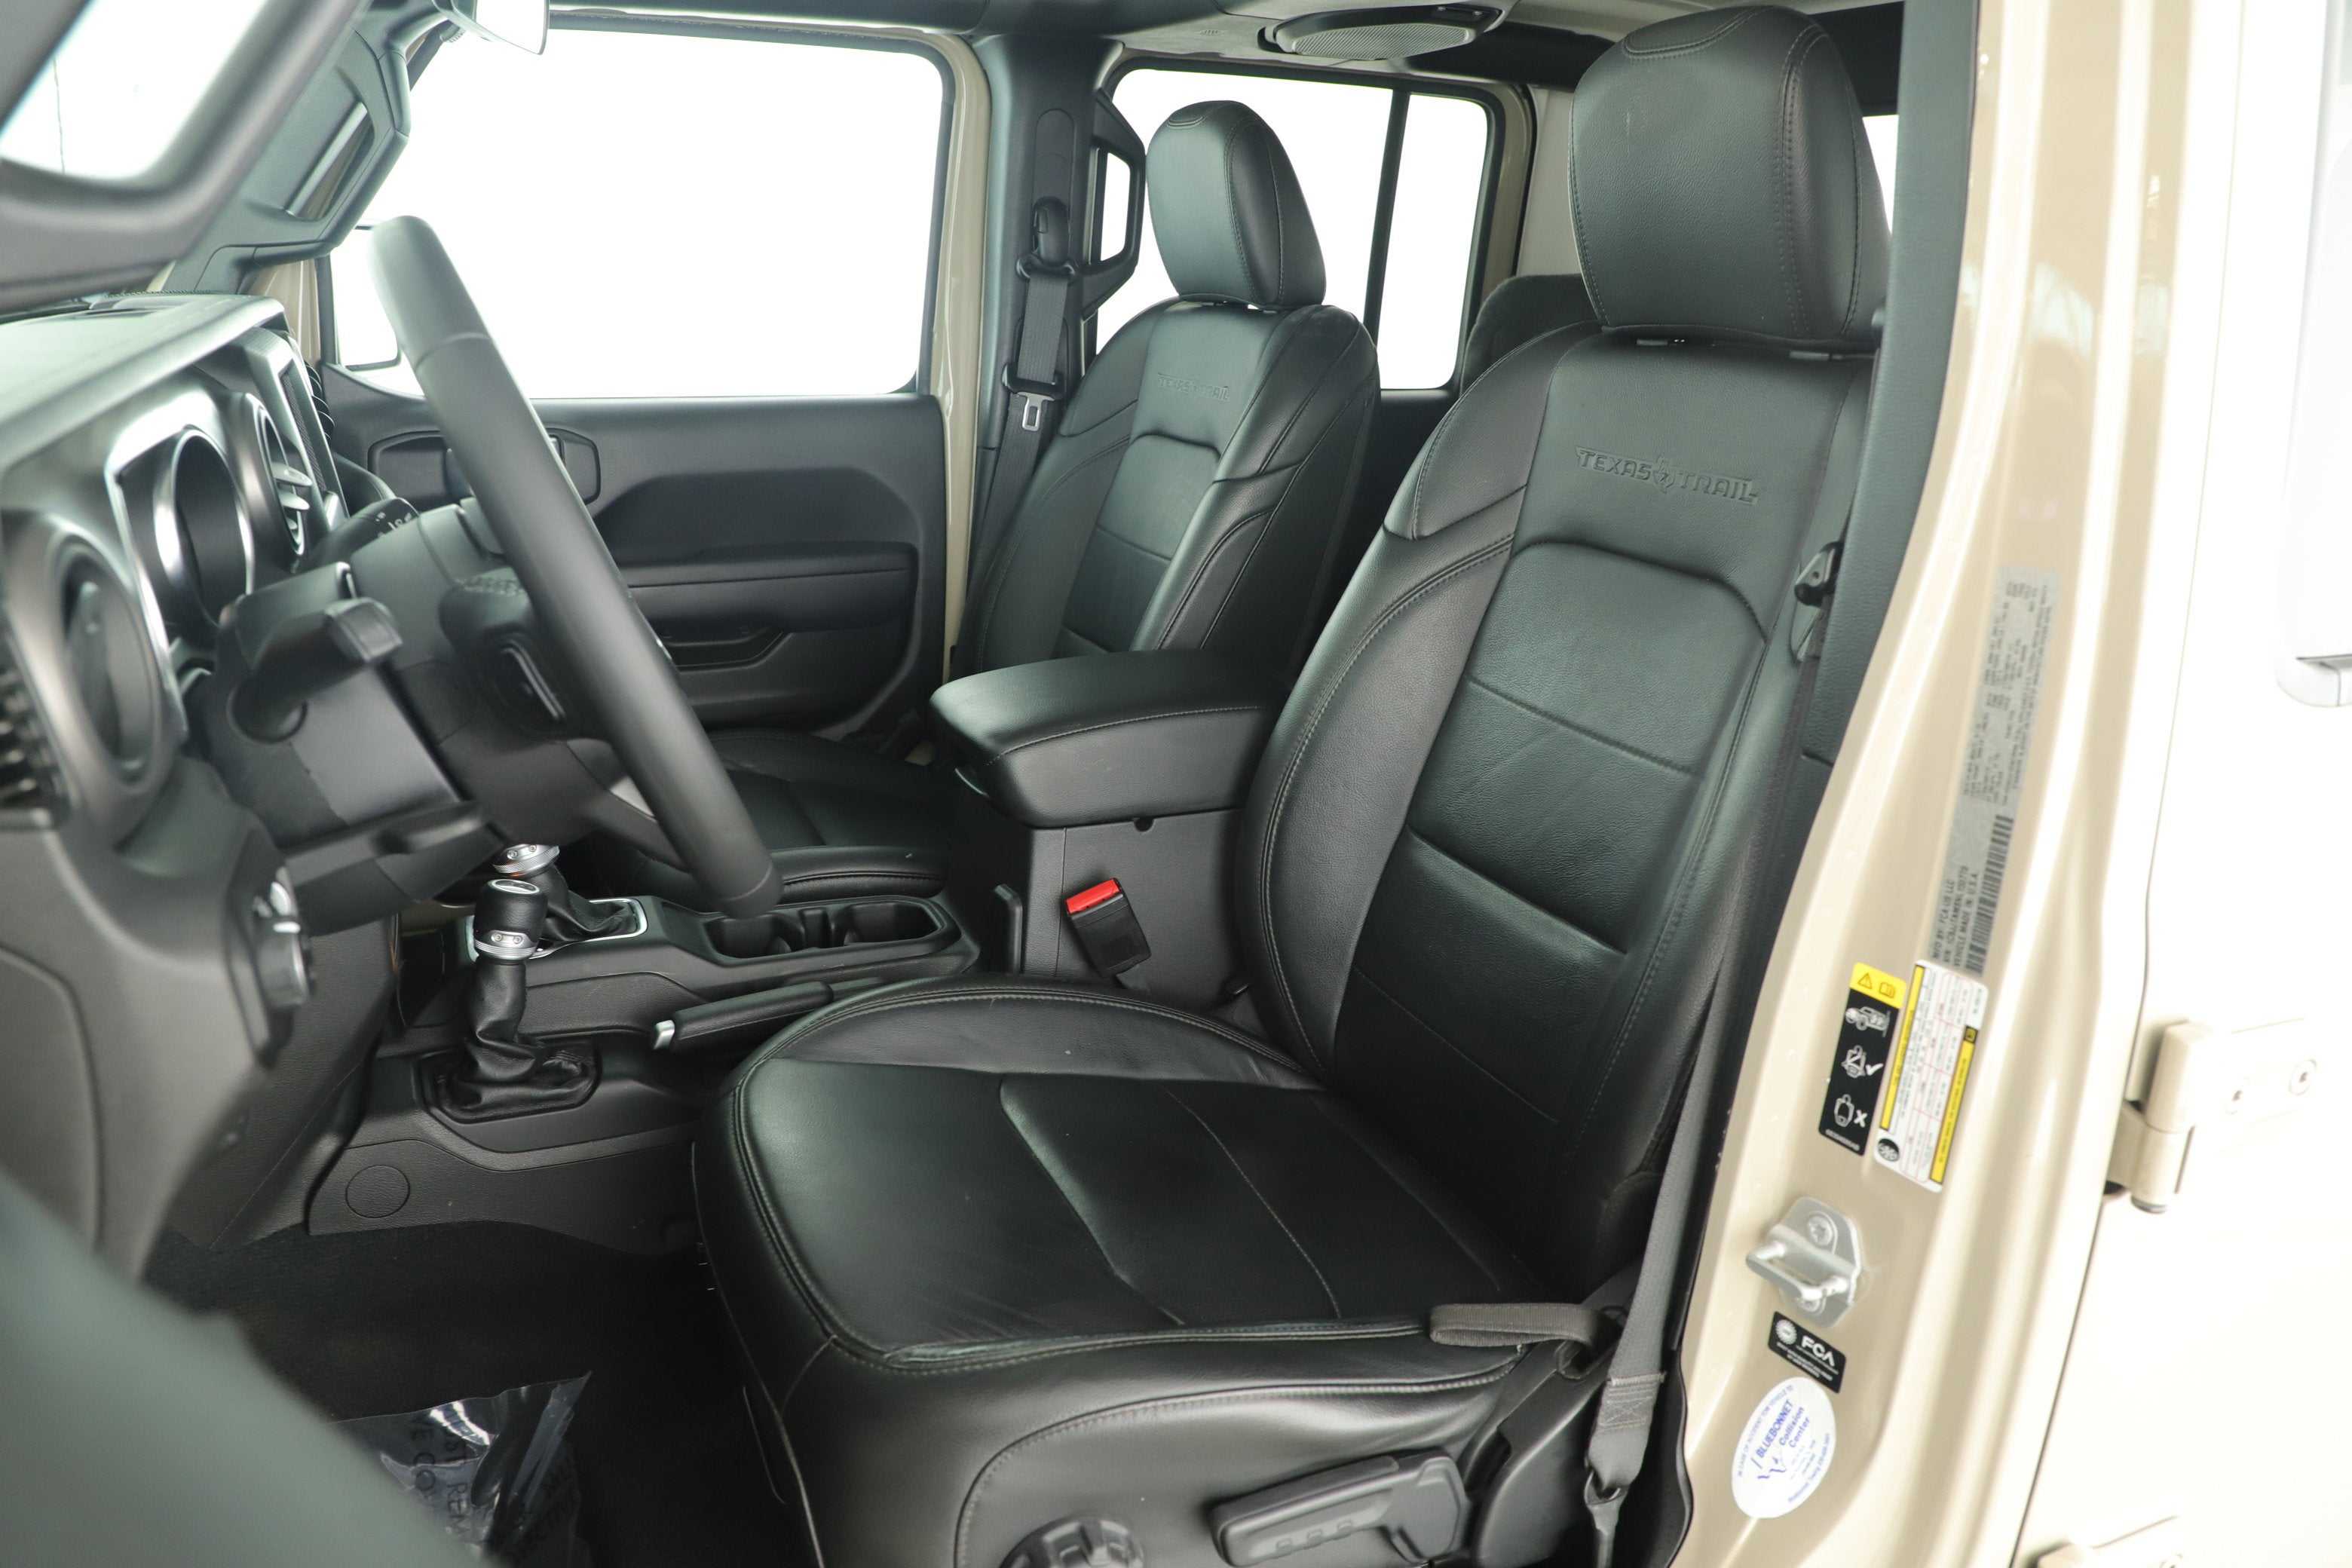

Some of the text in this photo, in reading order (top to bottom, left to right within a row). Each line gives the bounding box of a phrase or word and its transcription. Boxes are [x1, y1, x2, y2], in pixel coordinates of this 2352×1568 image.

[1579, 449, 1759, 503] TEXAS TRAIL
[1801, 1335, 1835, 1367] FCA
[1747, 1415, 1762, 1444] ACCIDENT
[1769, 1389, 1787, 1407] VEHICLE
[1756, 1399, 1794, 1458] BLUEBONNET
[1779, 1407, 1805, 1446] Collision
[1788, 1416, 1811, 1448] Center
